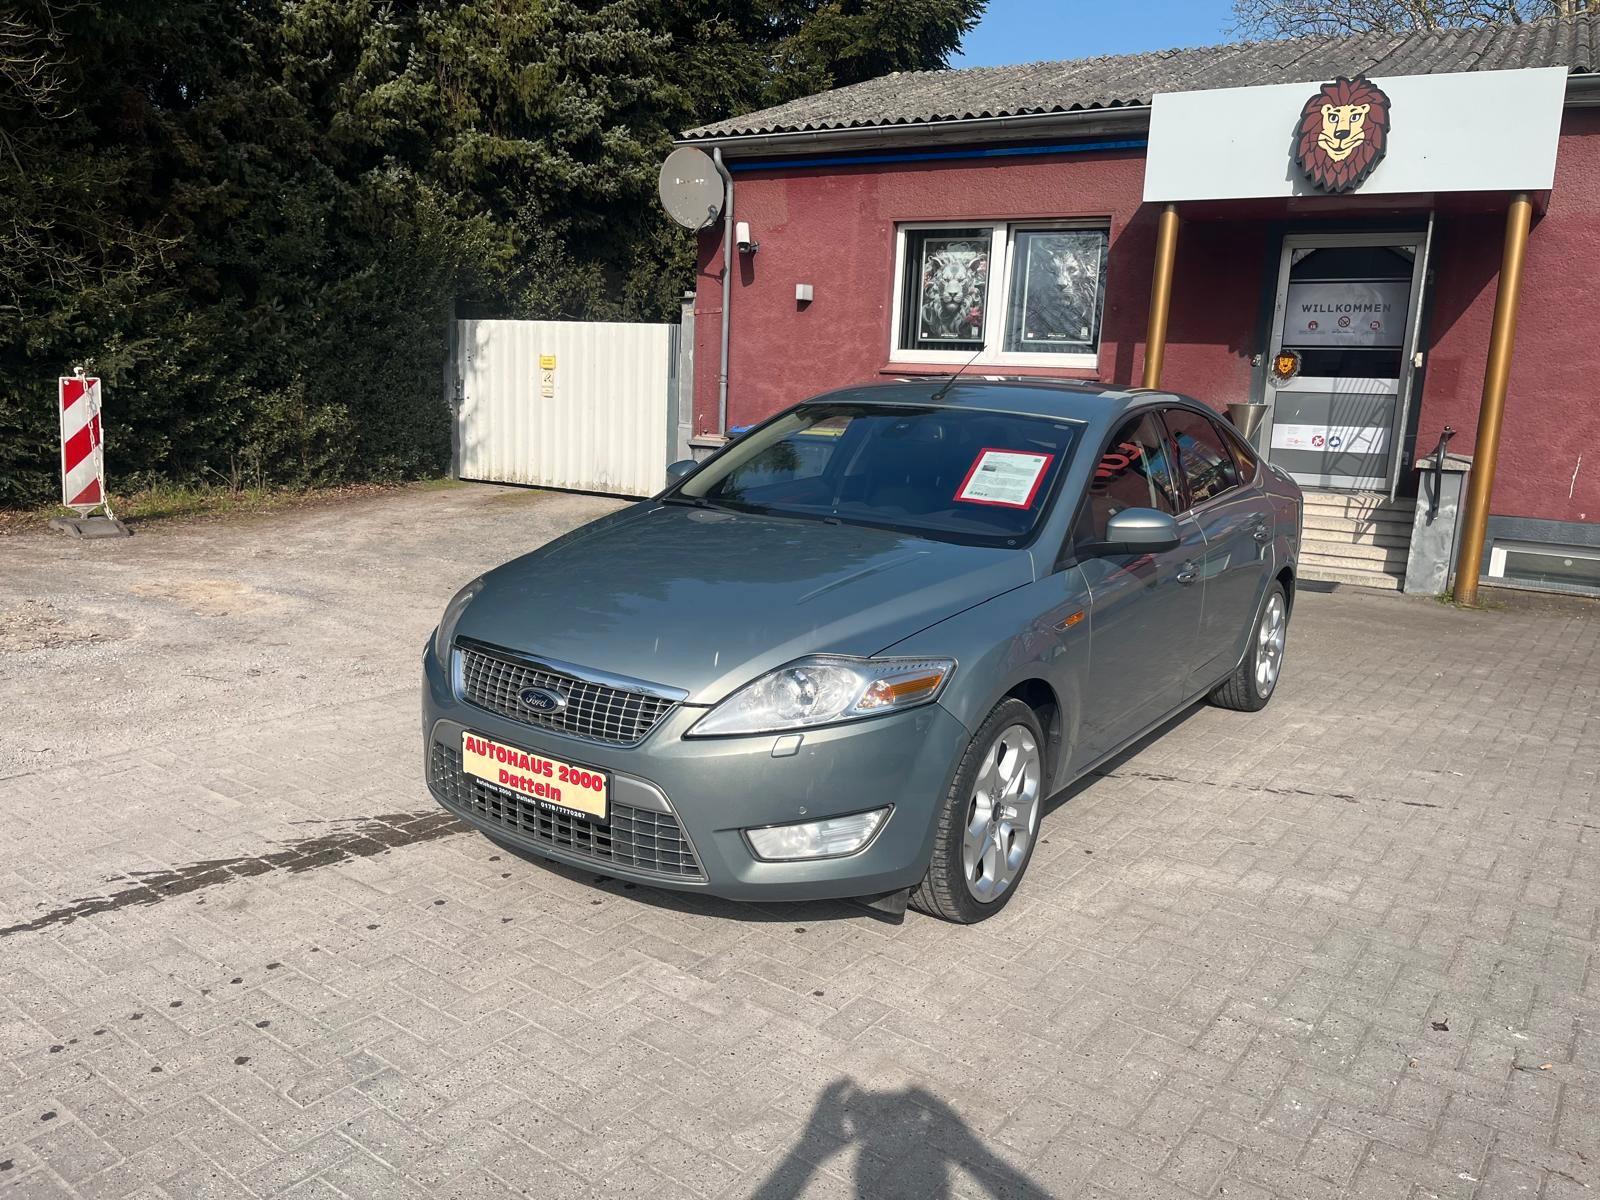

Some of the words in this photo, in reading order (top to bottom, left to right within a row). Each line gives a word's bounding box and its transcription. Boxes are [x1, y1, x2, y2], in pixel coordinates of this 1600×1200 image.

[1301, 303, 1392, 313] WILLKOMMEN
[525, 691, 548, 707] Ford
[465, 736, 553, 777] AUTOHAUS
[558, 765, 603, 792] 2000
[498, 768, 562, 801] Datteln
